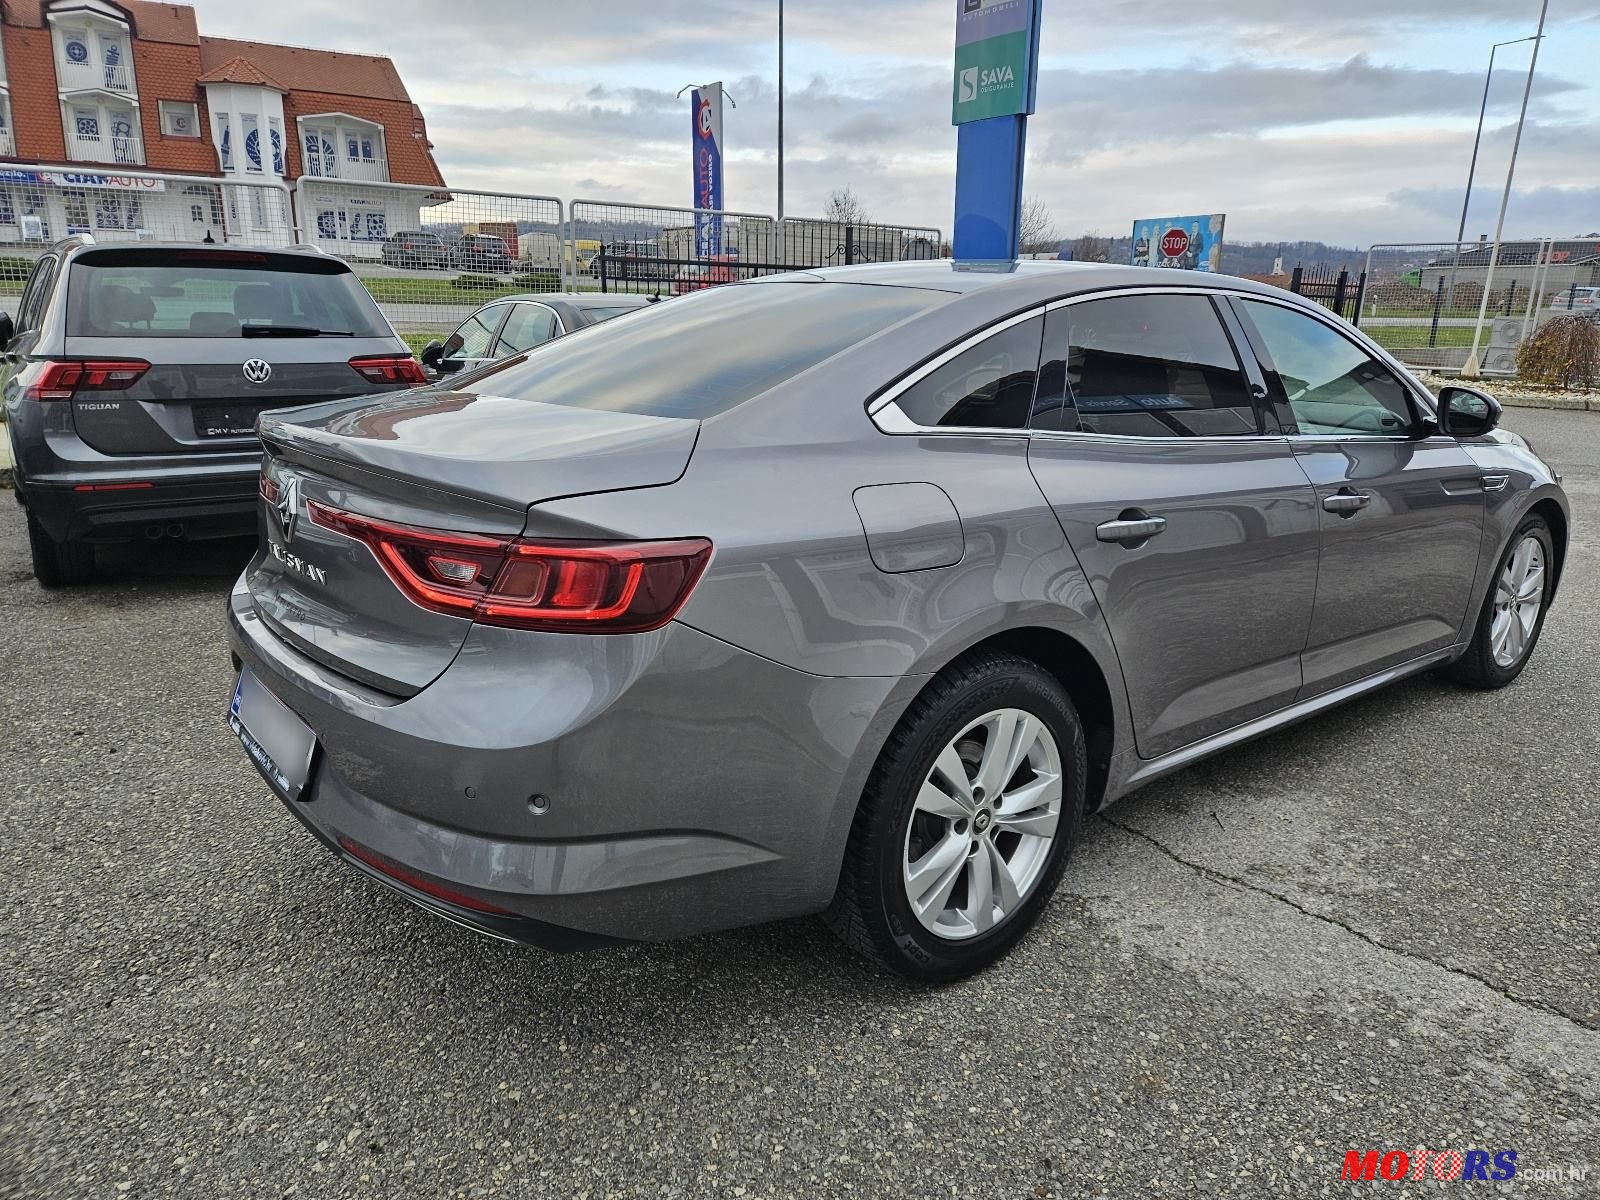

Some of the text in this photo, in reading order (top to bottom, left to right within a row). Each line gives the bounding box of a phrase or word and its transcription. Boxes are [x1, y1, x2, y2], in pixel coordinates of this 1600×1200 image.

[981, 65, 1014, 86] SAVA
[1163, 237, 1187, 249] STOP
[77, 403, 120, 411] TIGUAN
